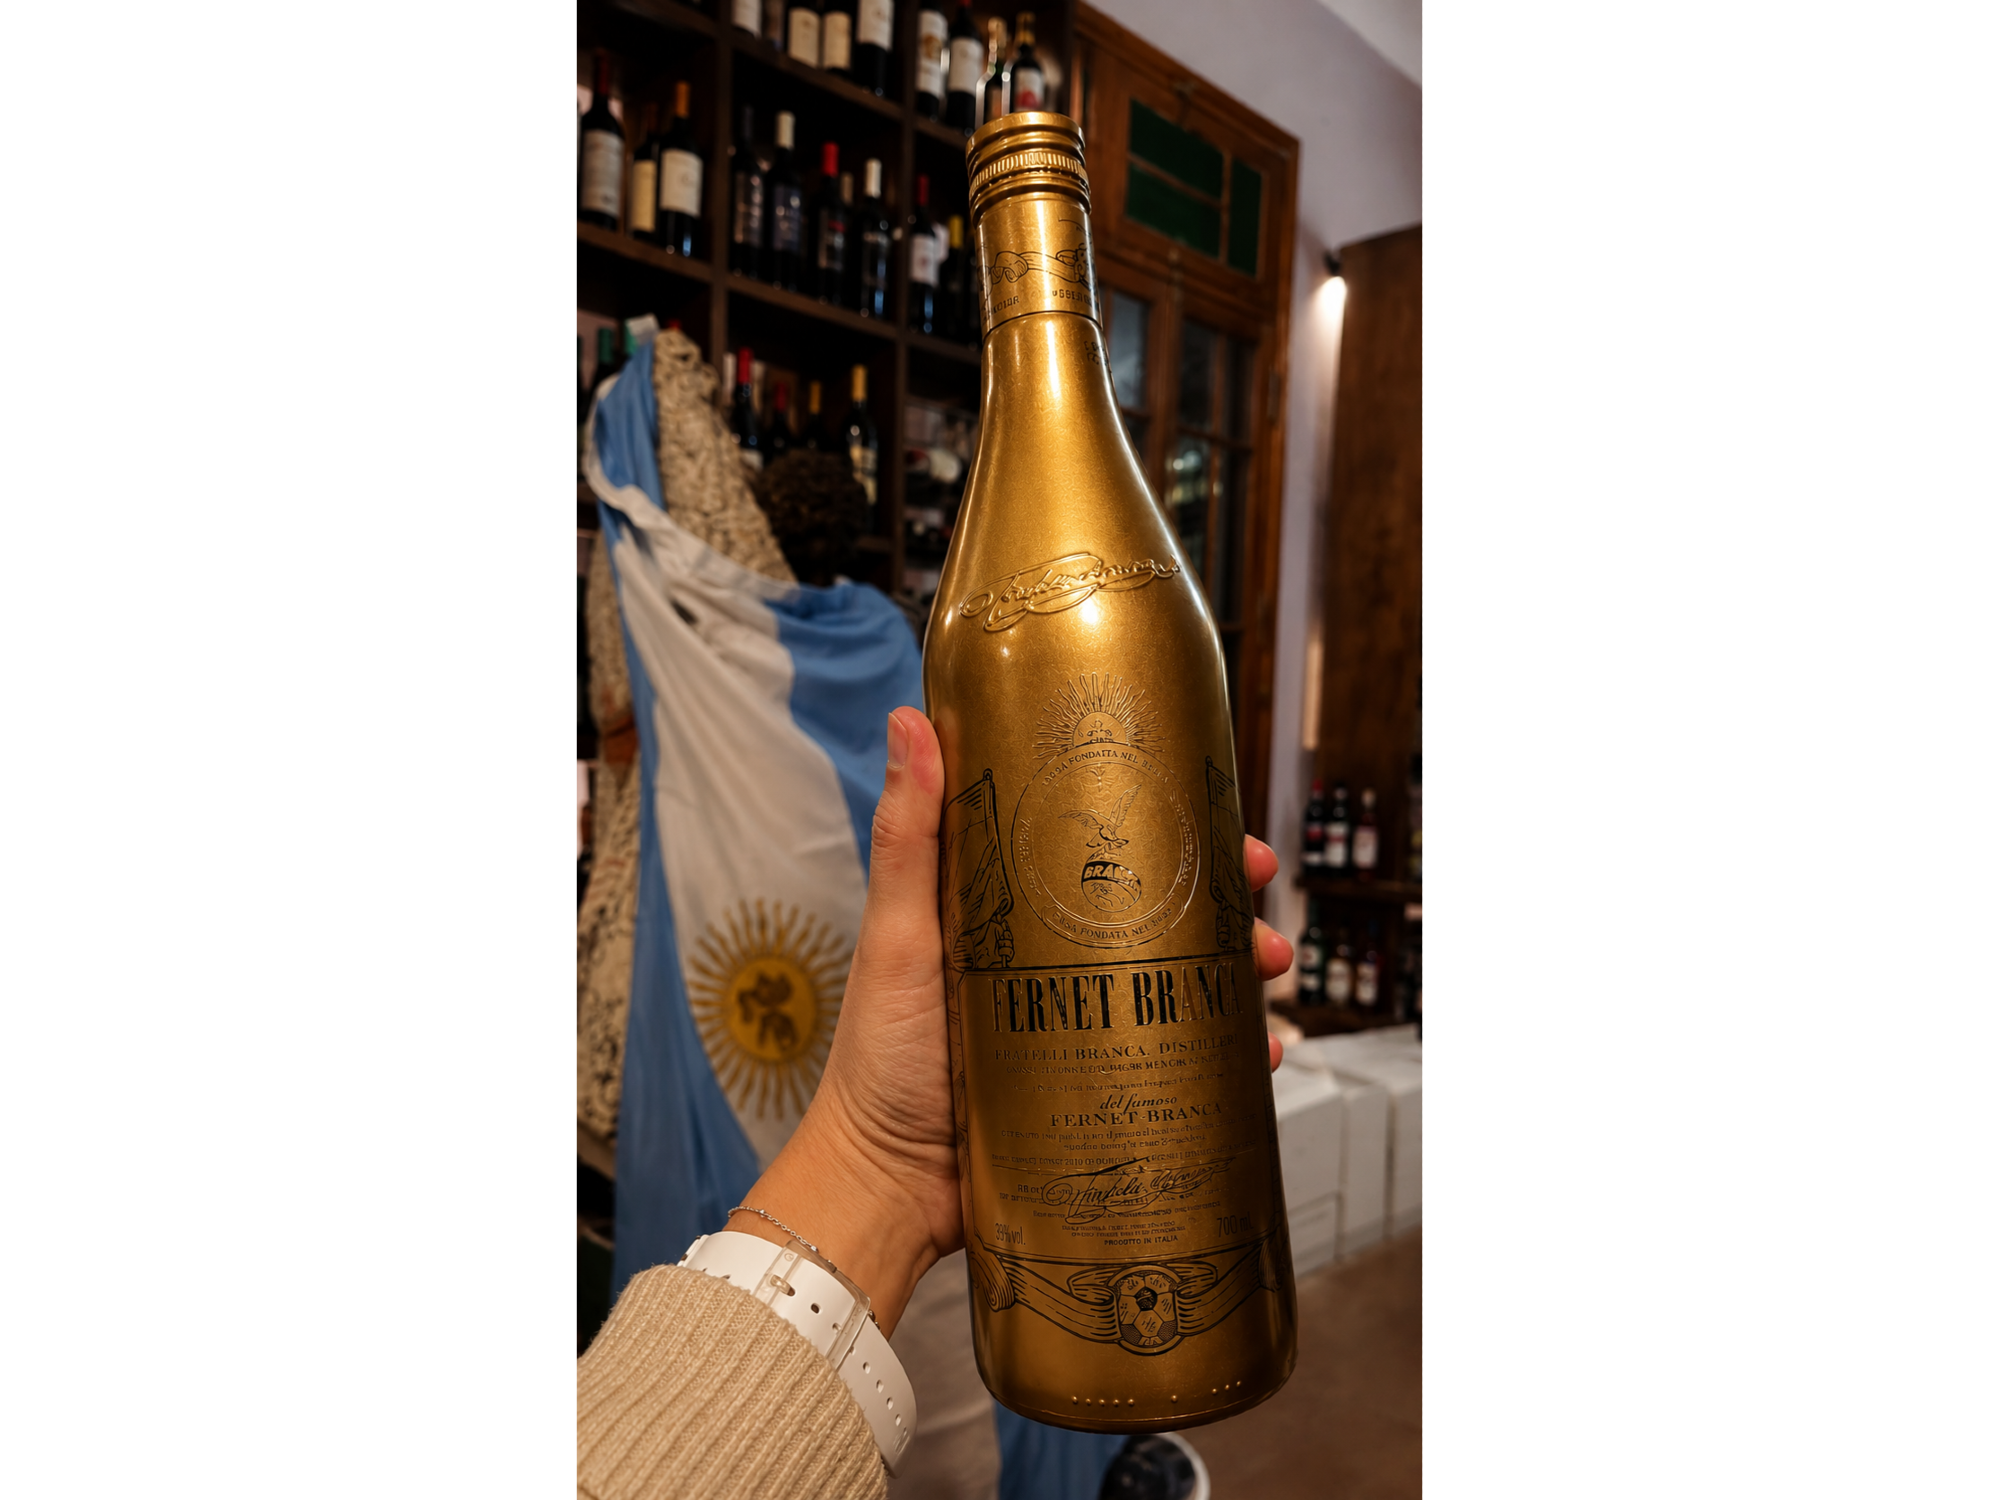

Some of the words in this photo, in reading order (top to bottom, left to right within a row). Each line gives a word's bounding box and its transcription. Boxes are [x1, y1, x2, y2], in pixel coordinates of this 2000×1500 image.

[1080, 928, 1129, 940] FONDATA
[987, 972, 1115, 1033] FERNET
[1130, 962, 1243, 1028] BRANCA
[994, 1048, 1068, 1061] FRATELLI
[1099, 1094, 1125, 1110] del
[1122, 1093, 1178, 1115] famoso
[1216, 1214, 1238, 1238] 700
[1154, 1234, 1178, 1244] ITALIA
